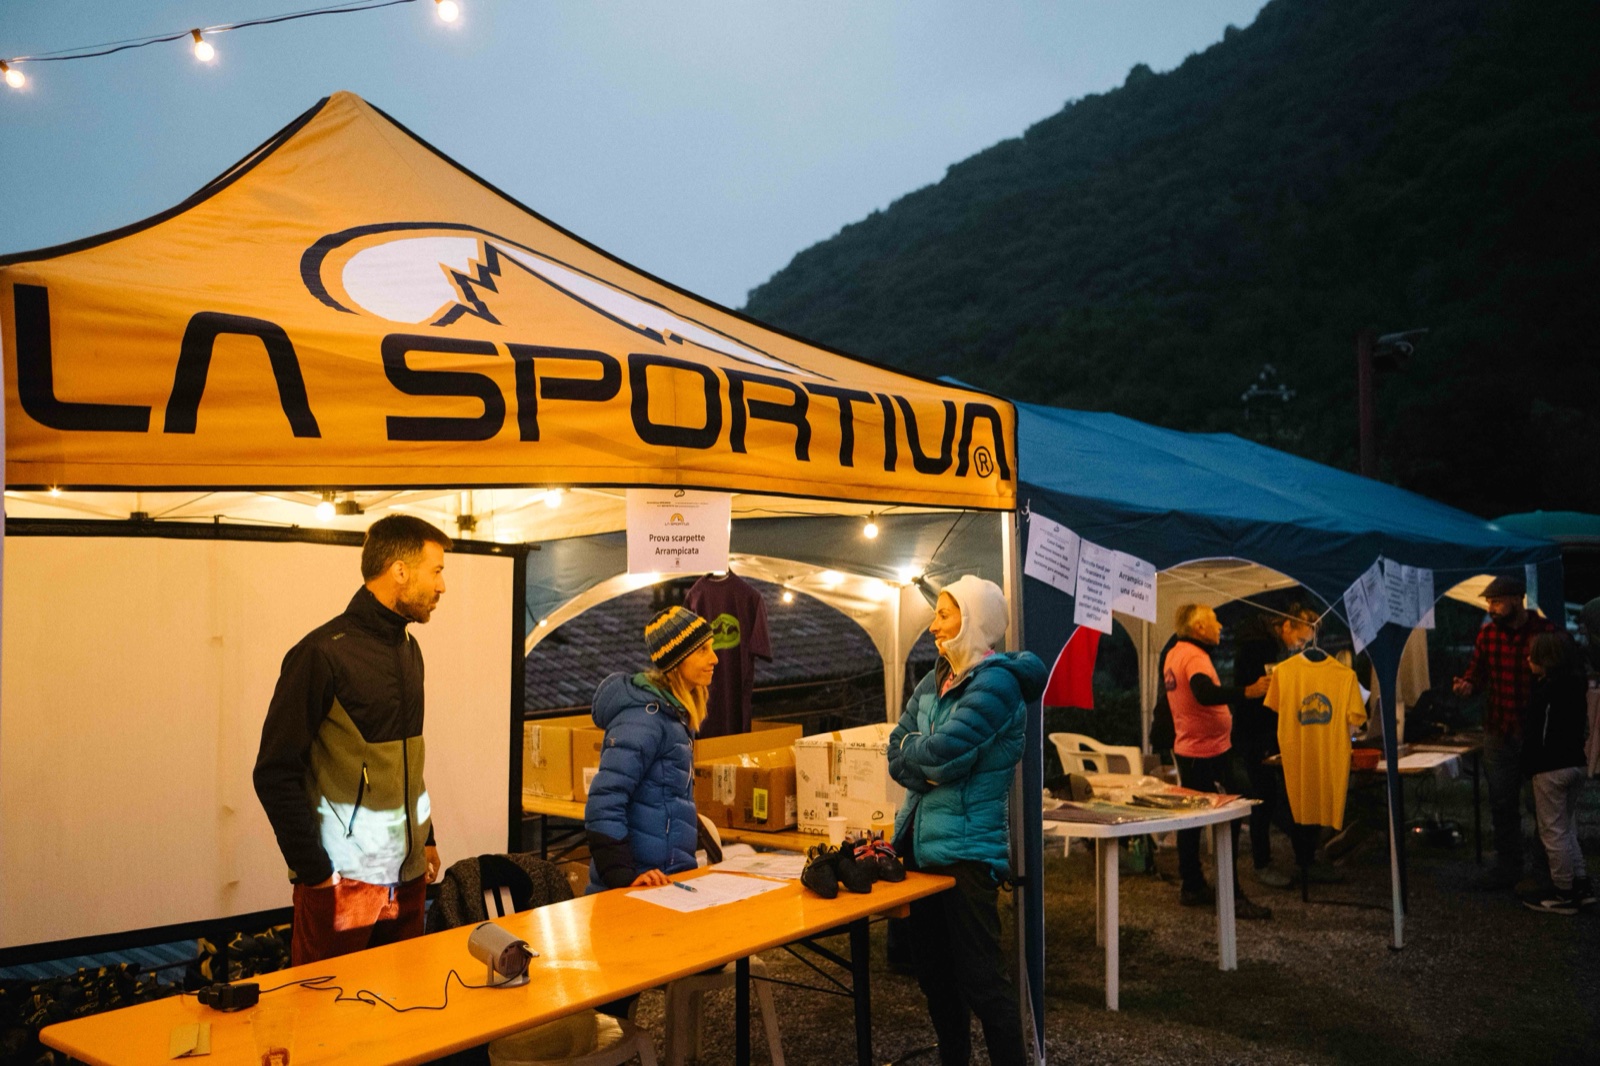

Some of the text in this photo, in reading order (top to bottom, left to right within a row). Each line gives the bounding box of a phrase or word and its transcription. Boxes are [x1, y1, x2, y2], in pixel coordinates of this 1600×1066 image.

[13, 283, 1011, 480] LA SPORTIVA
[649, 534, 705, 543] Prova scarpette
[655, 547, 699, 556] Arrampicata
[1118, 571, 1144, 588] Arrampica
[1120, 587, 1130, 596] una
[1131, 589, 1145, 601] Guida
